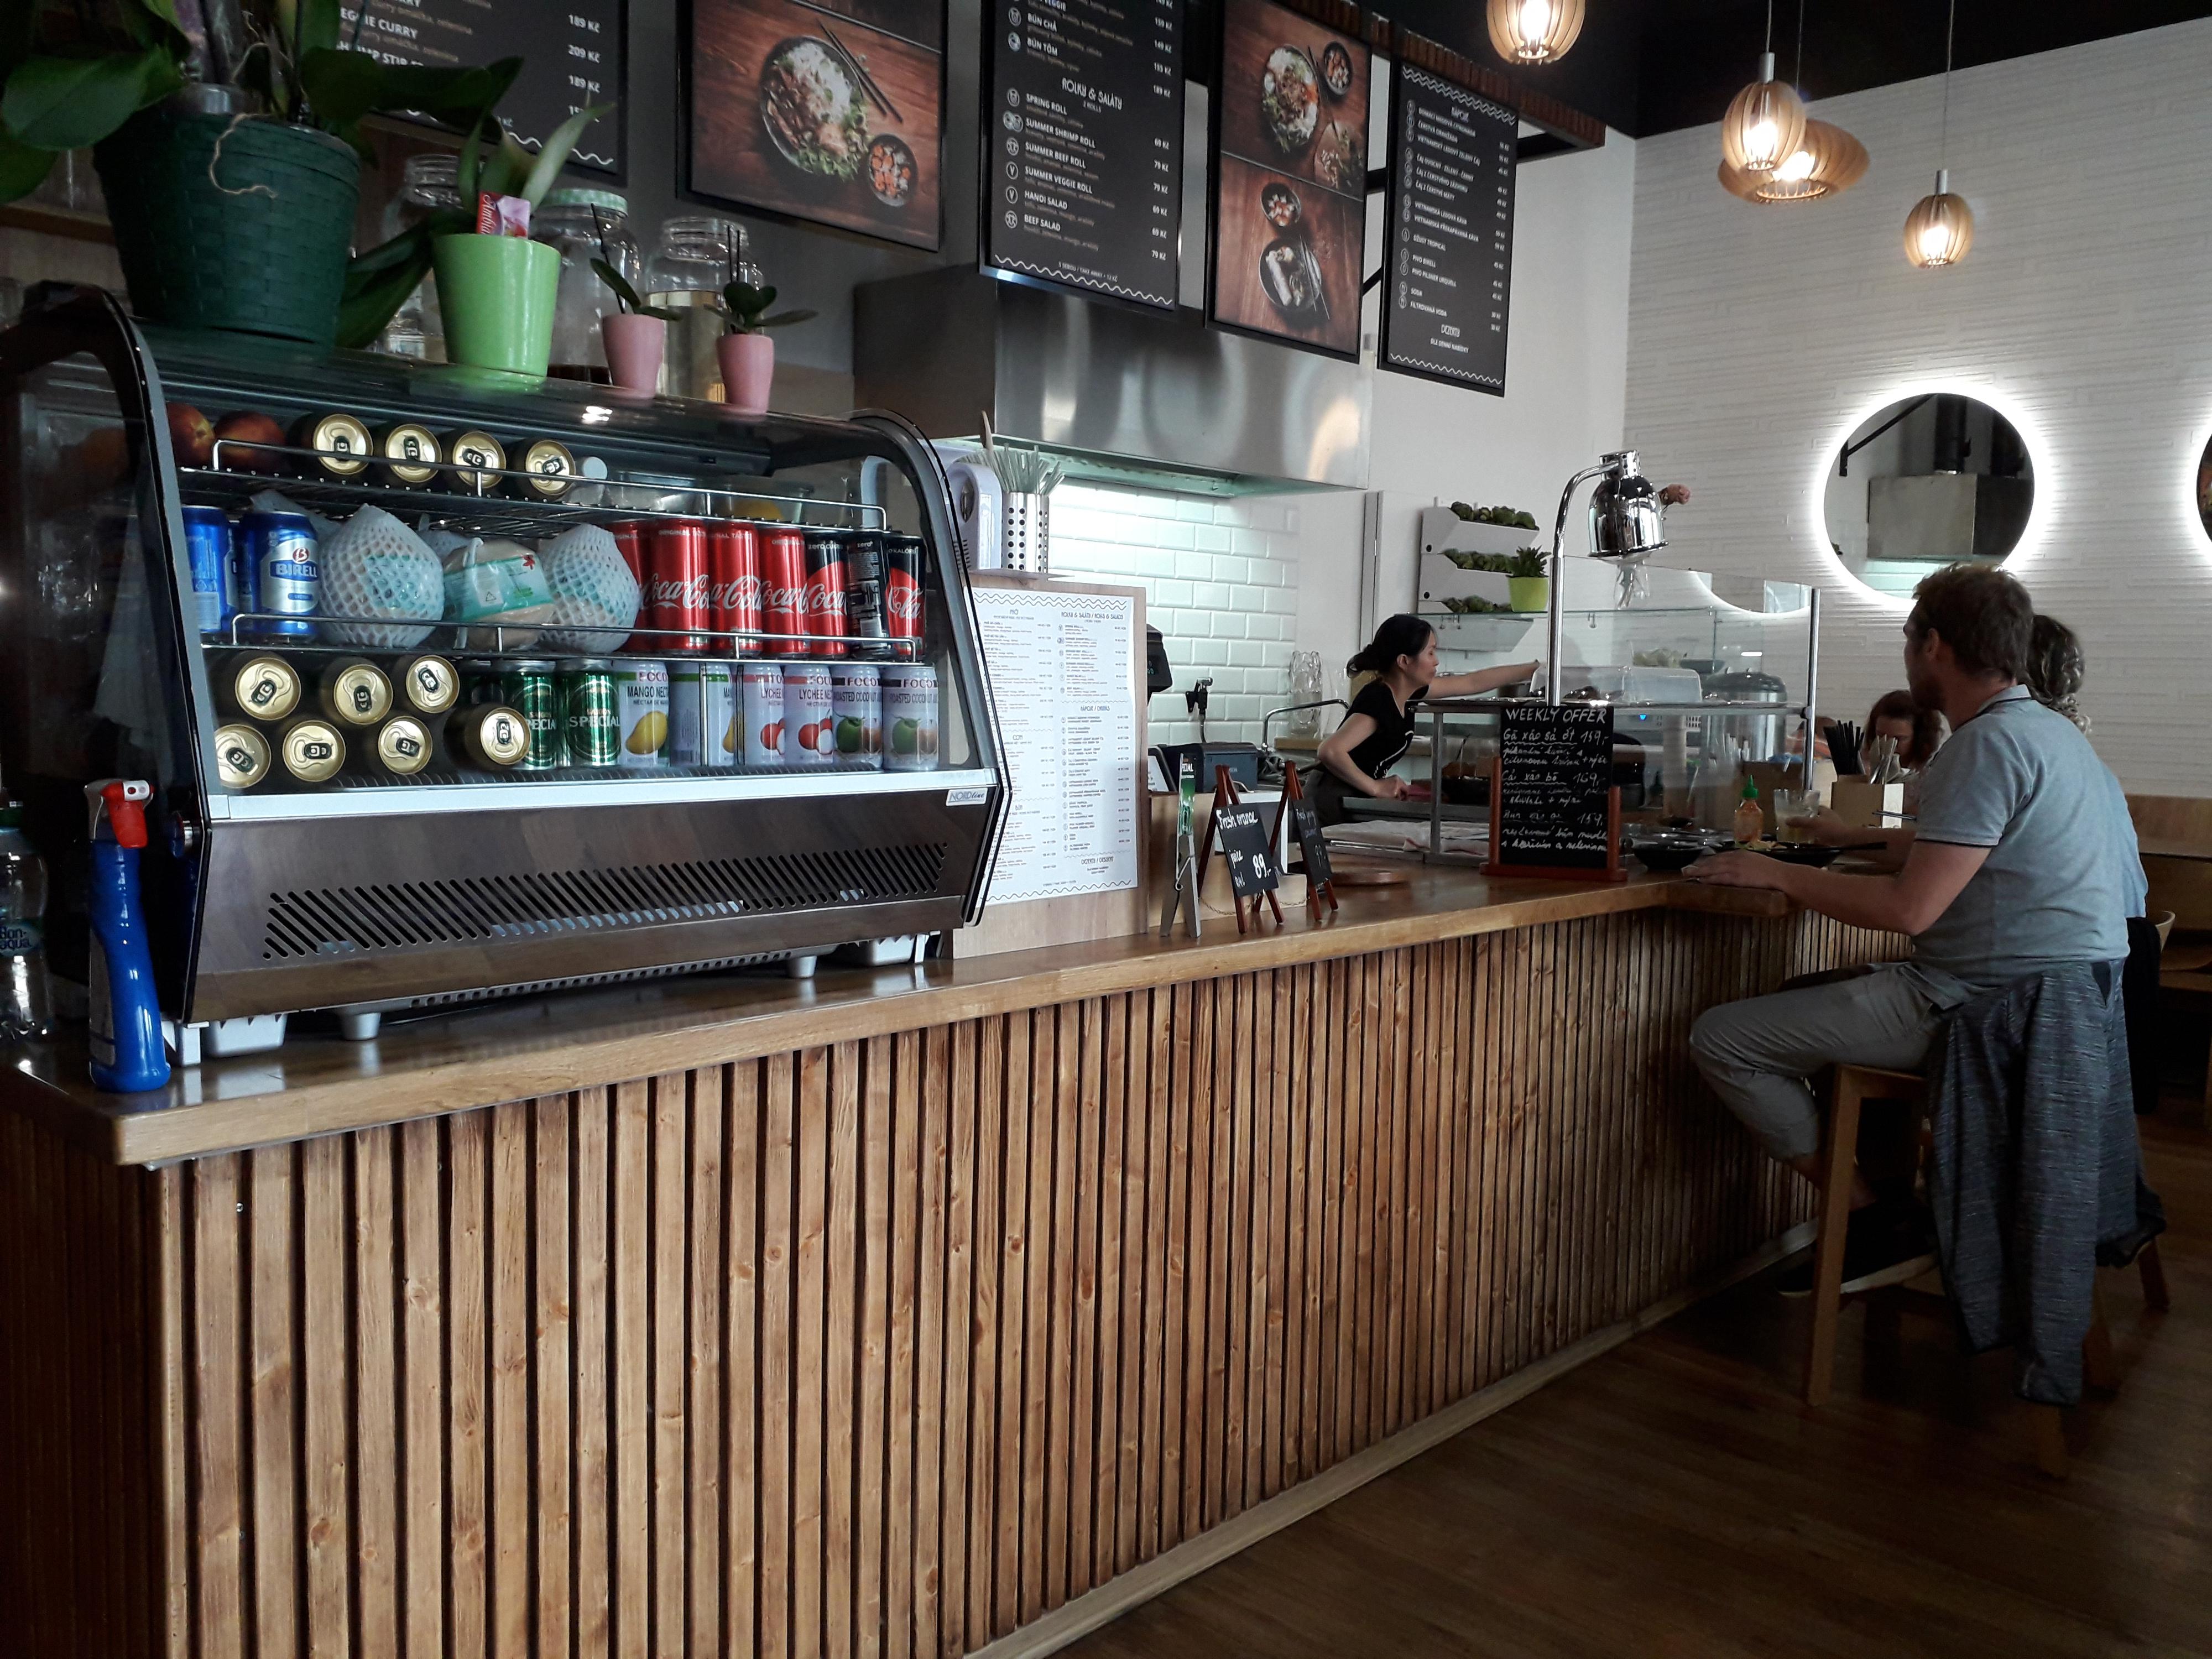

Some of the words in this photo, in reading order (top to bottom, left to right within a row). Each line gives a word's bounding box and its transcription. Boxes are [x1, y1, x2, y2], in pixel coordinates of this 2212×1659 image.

[378, 18, 419, 40] CURRY
[1062, 77, 1087, 97] ROLKY
[1088, 87, 1097, 101] &
[1098, 90, 1123, 110] SALÁTY
[1026, 93, 1050, 109] SPRING
[1051, 101, 1068, 116] ROLL
[1026, 117, 1054, 135] SUMMER
[1055, 127, 1079, 142] SHRIMP
[1080, 135, 1096, 149] ROLL
[1025, 141, 1053, 158] SUMMER
[1054, 150, 1069, 164] BEEF
[1070, 156, 1087, 169] ROLL
[1025, 165, 1053, 182] SUMMER
[1053, 175, 1076, 189] VEGGIE
[1077, 181, 1093, 194] ROLL
[1024, 190, 1047, 205] HANOI
[1047, 197, 1068, 210] SALAD
[1024, 213, 1039, 226] BEEF
[1040, 219, 1061, 232] SALAD
[275, 563, 317, 577] BIRELL
[628, 685, 655, 698] MANGO
[847, 677, 877, 687] FOCO
[903, 679, 933, 688] FOCO
[799, 688, 823, 700] LYCHEE
[569, 716, 620, 728] SPECIAL
[1505, 707, 1561, 723] WEEKLY
[1562, 707, 1608, 724] OFFER
[1216, 807, 1237, 830] Fresh
